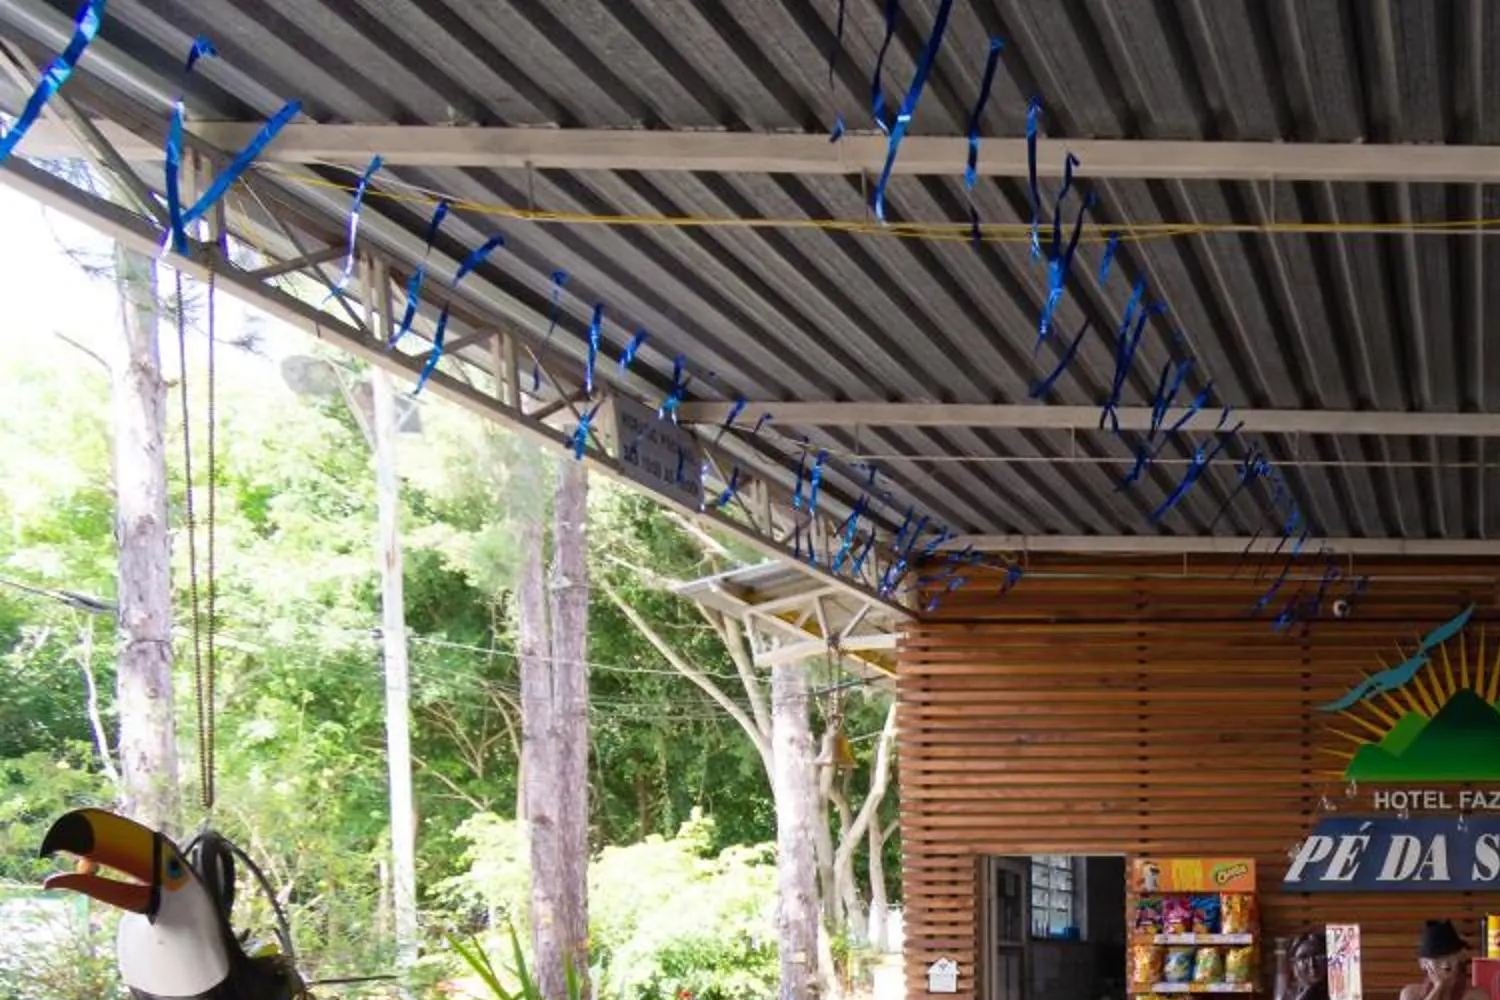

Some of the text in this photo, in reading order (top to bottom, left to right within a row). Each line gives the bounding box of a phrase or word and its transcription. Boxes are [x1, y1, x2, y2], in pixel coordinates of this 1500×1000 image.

[1373, 790, 1452, 810] HOTEL
[1283, 821, 1374, 882] PÉ
[1377, 834, 1451, 882] DA
